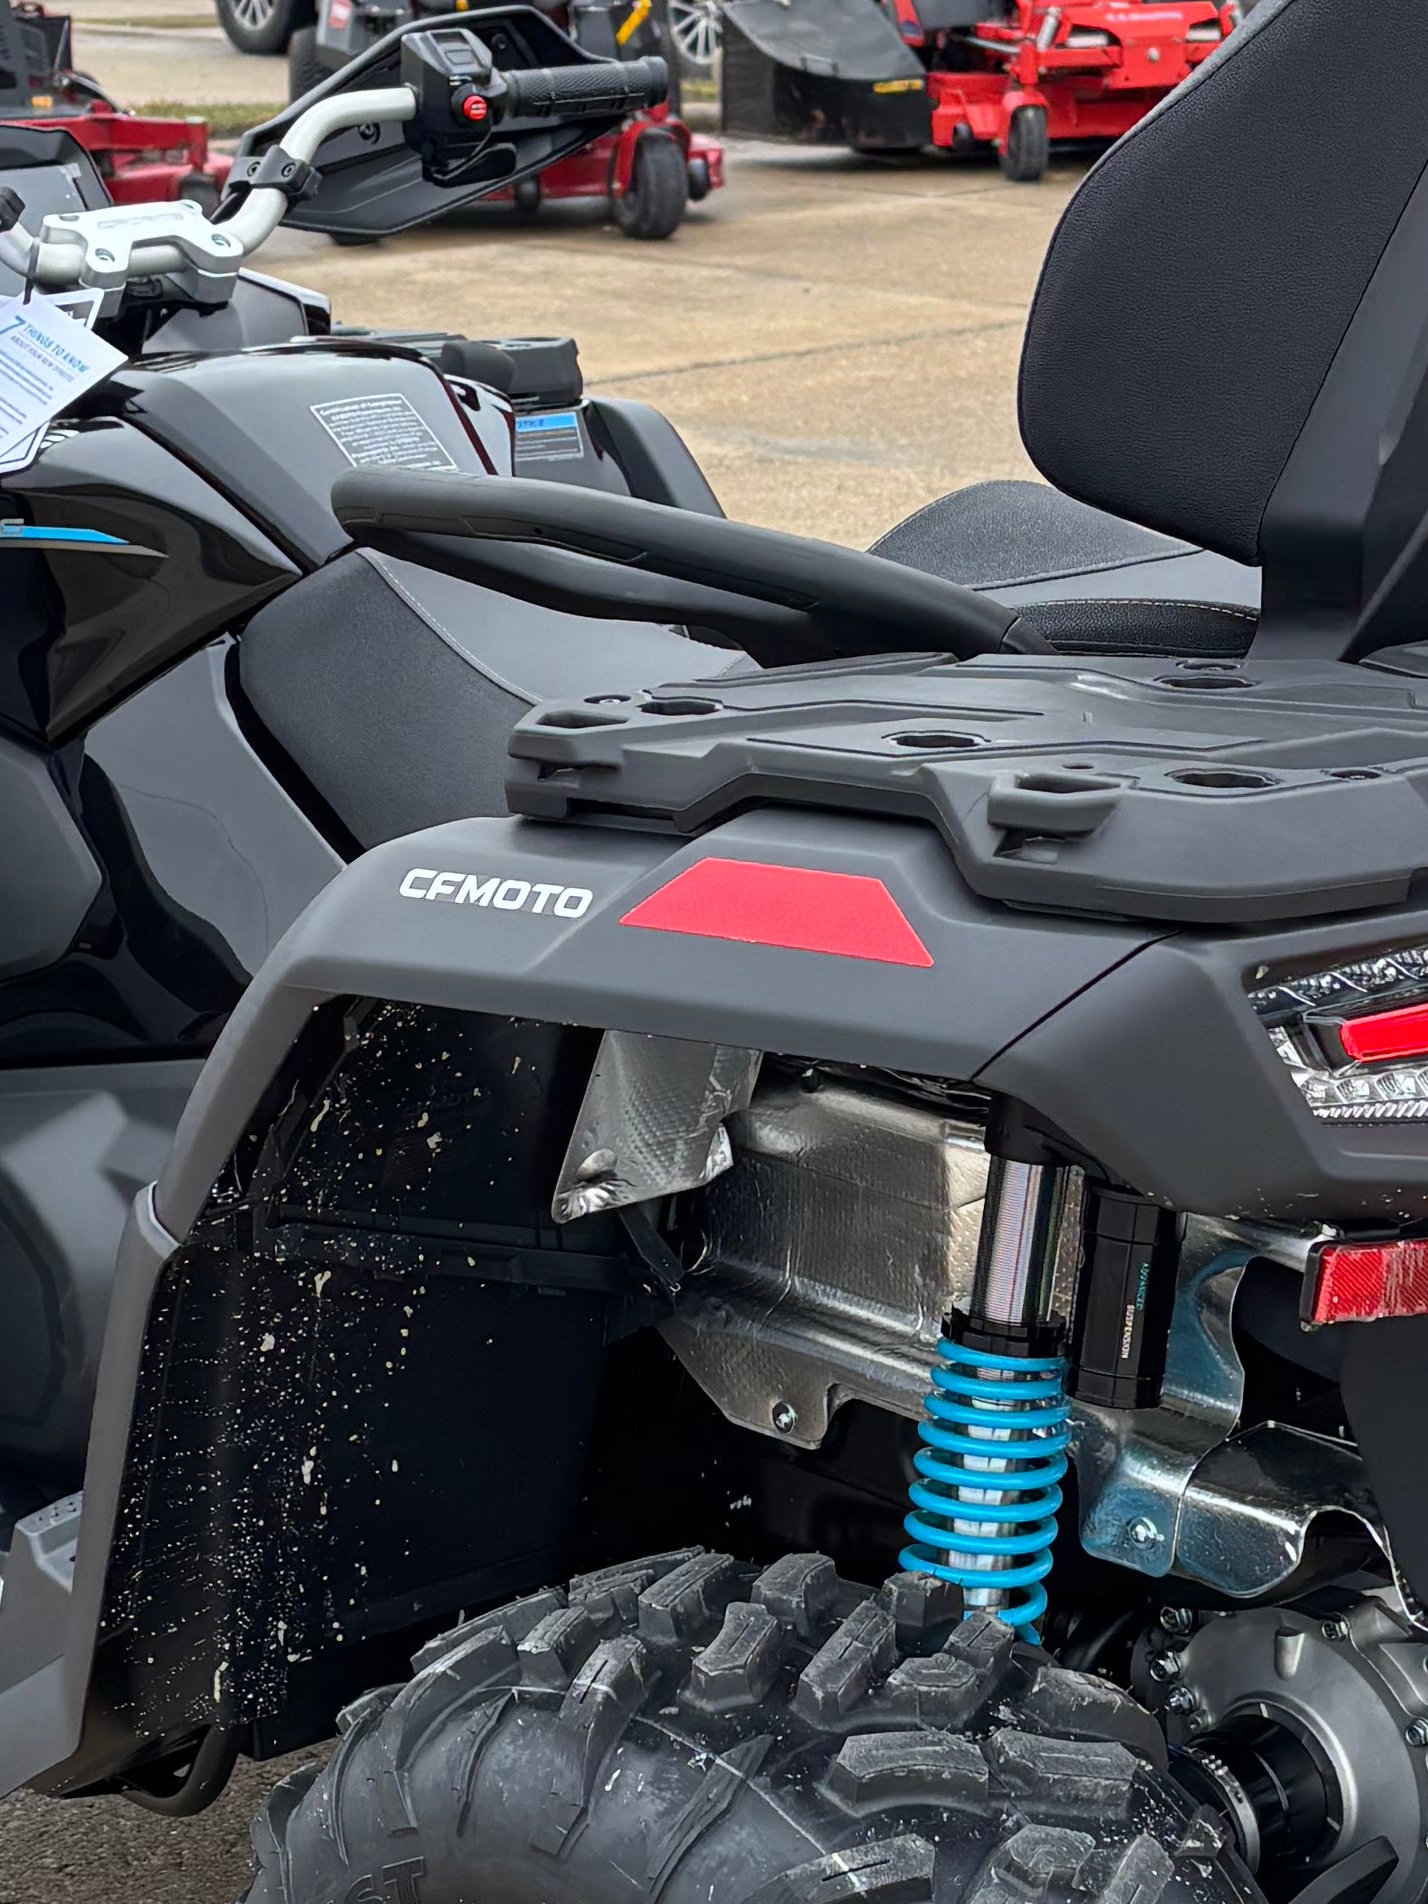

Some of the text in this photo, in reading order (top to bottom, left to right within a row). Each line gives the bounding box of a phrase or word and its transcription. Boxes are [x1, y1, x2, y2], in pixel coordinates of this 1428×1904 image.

[0, 314, 27, 336] 7
[22, 324, 55, 350] THINGS
[51, 344, 66, 357] TO
[63, 353, 90, 374] KNOW
[399, 868, 594, 919] CFMOTO
